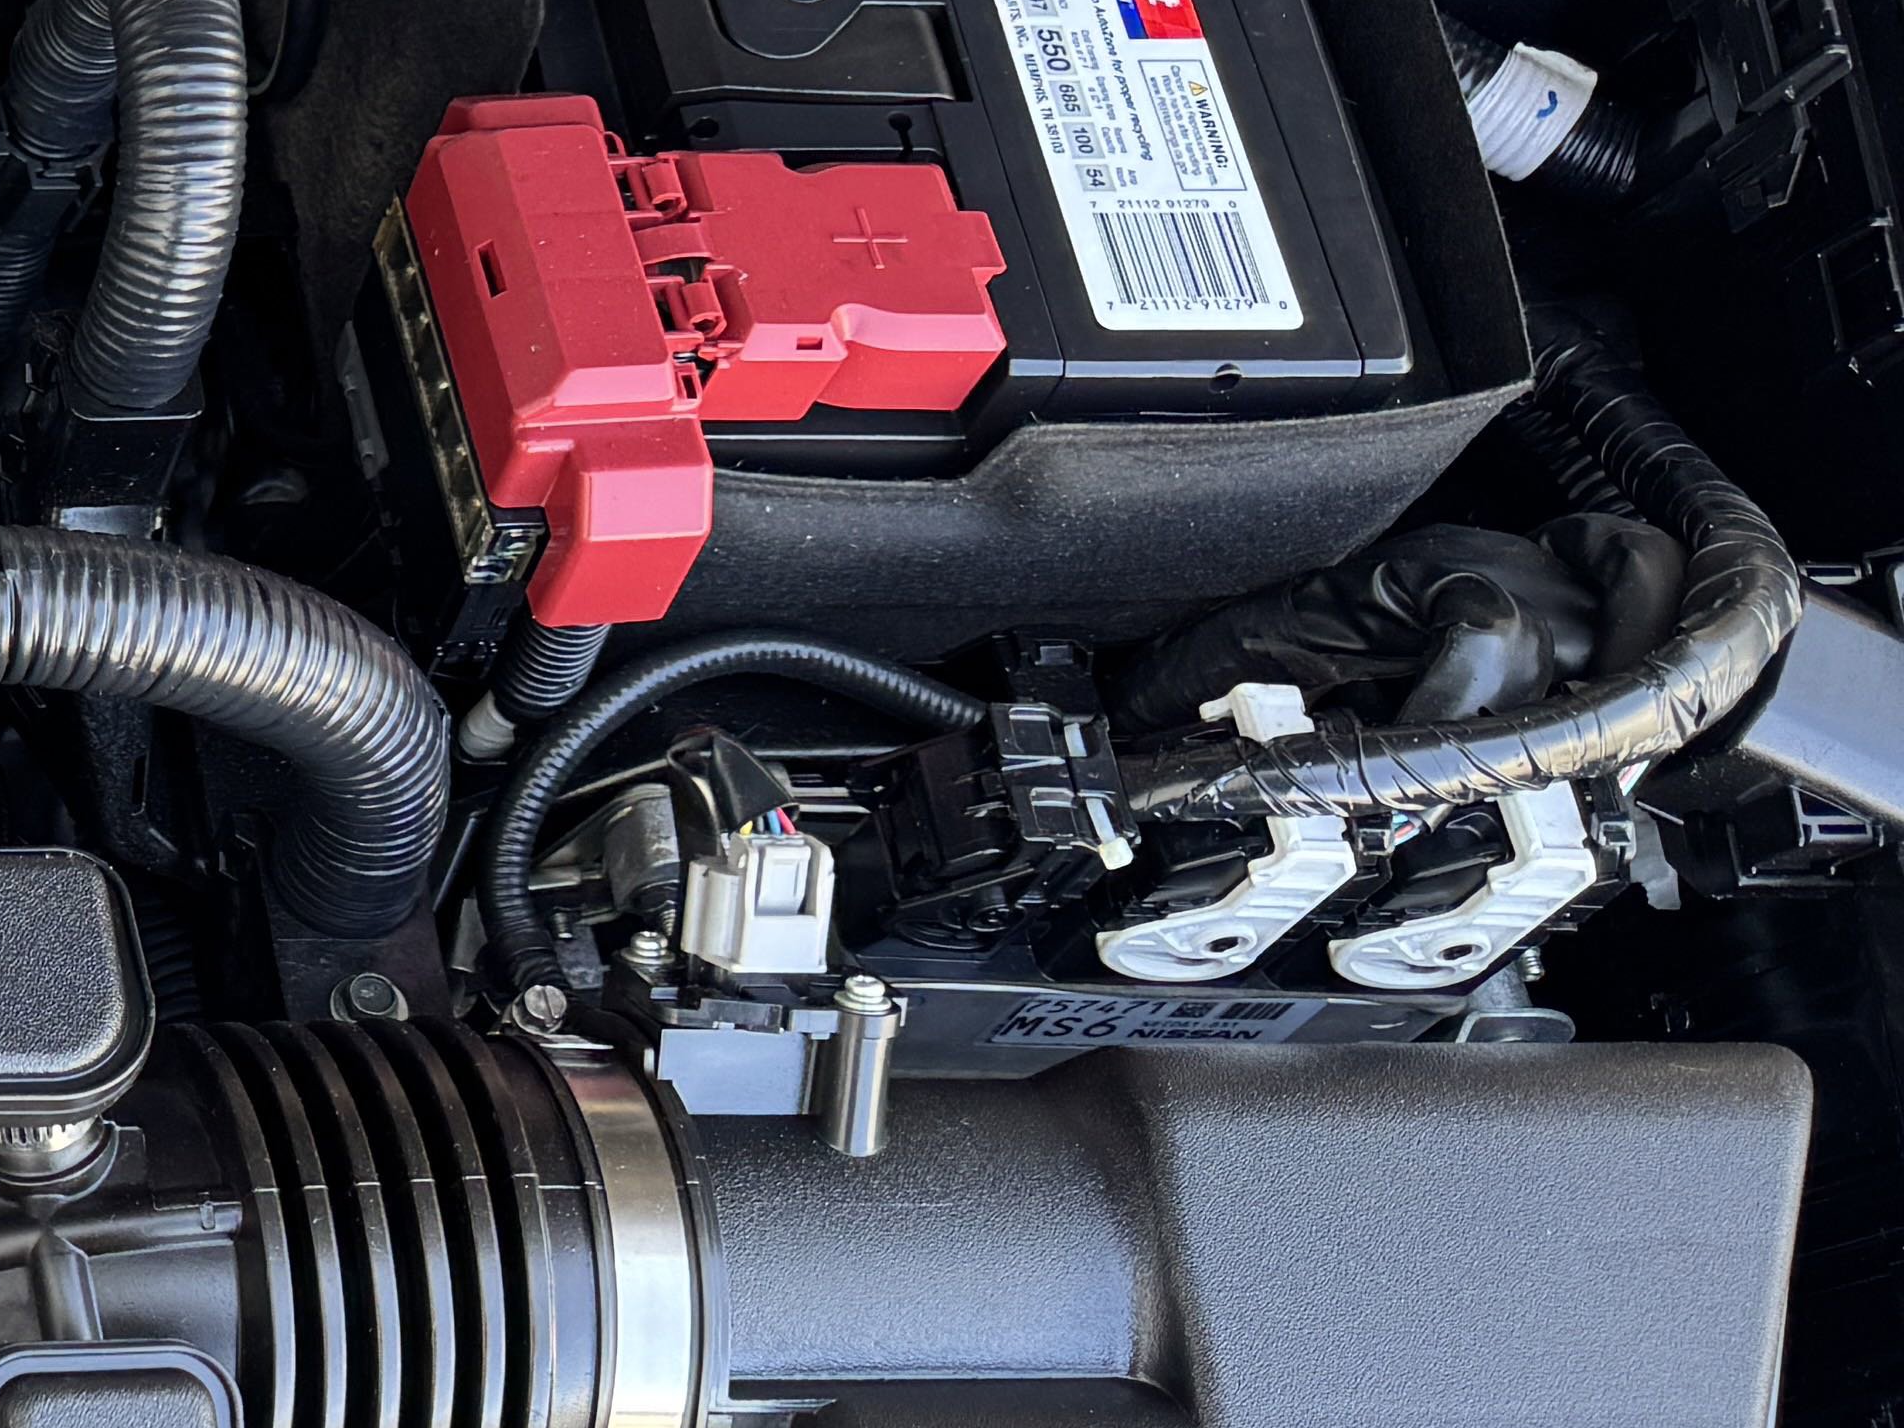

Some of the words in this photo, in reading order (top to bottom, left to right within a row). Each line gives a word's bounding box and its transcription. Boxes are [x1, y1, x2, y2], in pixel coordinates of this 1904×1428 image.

[1092, 6, 1120, 55] AutoZone
[1110, 59, 1126, 71] for
[1035, 28, 1073, 71] 550
[1057, 83, 1082, 112] 685
[1070, 127, 1095, 153] 100
[1084, 168, 1107, 187] 54
[1113, 75, 1137, 109] proper
[1126, 113, 1155, 160] recycling
[1194, 99, 1230, 168] WARNING:
[1140, 299, 1193, 311] 21112
[1200, 299, 1254, 311] 91279
[1127, 1028, 1263, 1040] NISSAN
